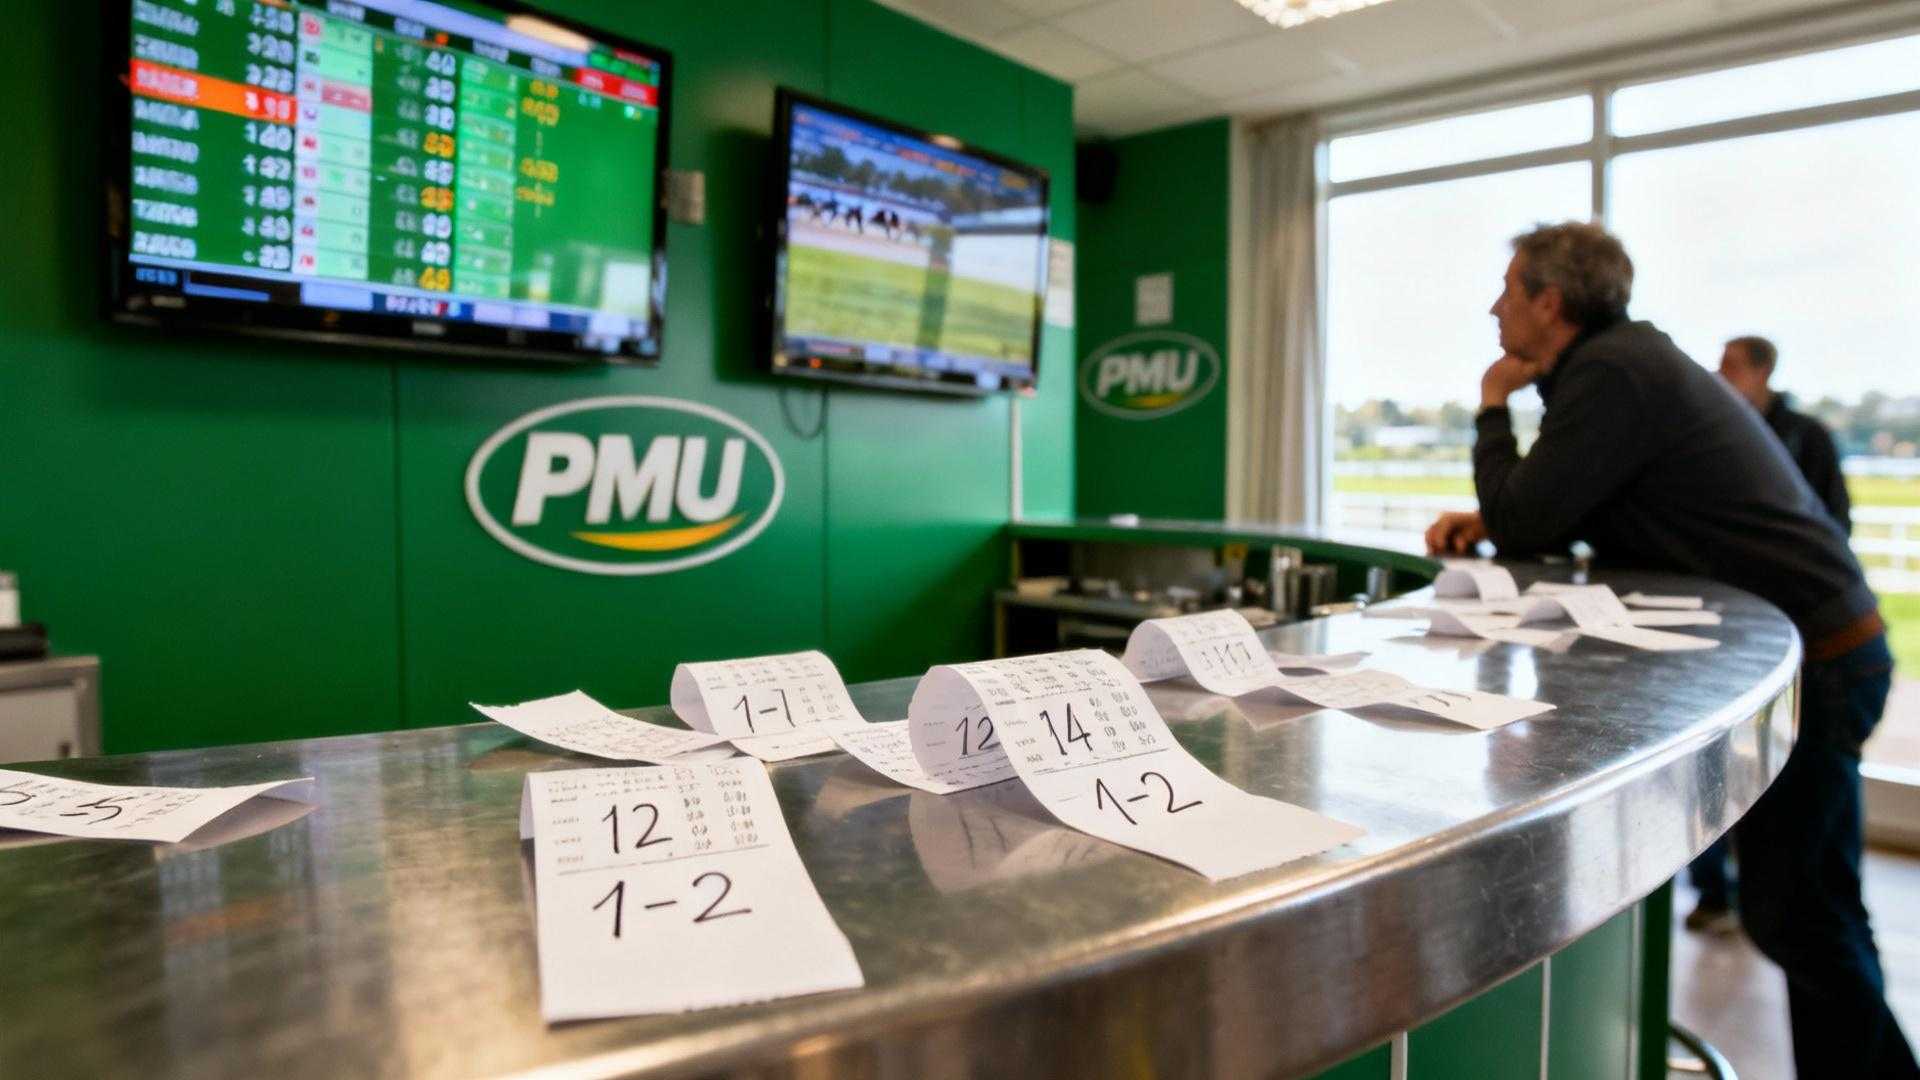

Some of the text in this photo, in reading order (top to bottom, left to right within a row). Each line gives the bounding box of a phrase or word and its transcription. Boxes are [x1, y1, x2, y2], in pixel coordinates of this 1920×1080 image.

[1097, 350, 1199, 398] PMU
[511, 431, 747, 527] PMU
[954, 715, 1000, 756] 12
[1039, 702, 1093, 756] 14
[1095, 771, 1203, 826] 1-2
[602, 803, 673, 854] 12
